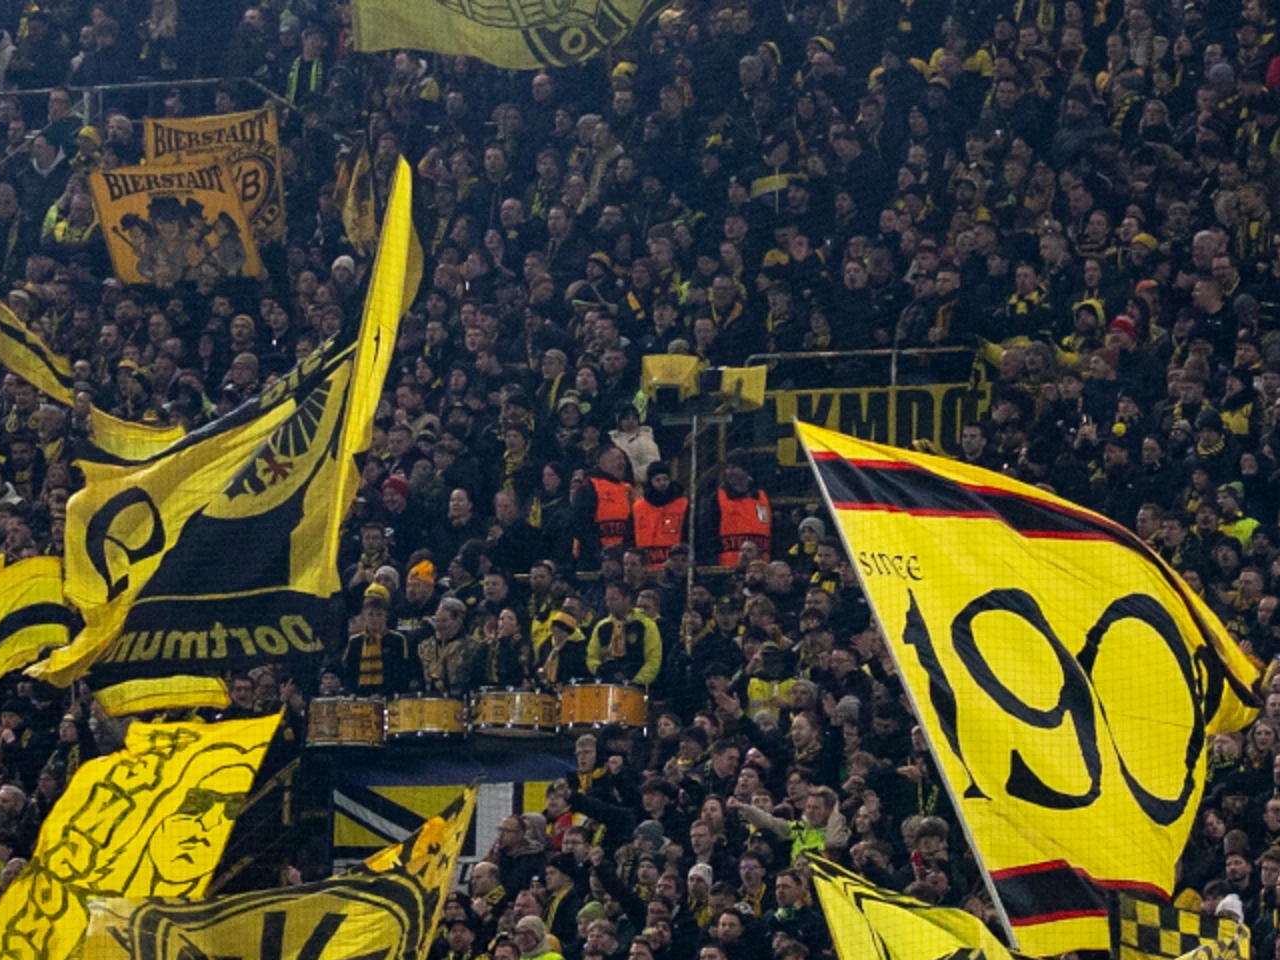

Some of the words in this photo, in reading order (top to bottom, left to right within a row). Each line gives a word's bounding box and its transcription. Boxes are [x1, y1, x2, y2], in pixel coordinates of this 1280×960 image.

[152, 111, 269, 158] BIERSTADT
[103, 165, 226, 201] BIERSTADT
[859, 551, 924, 581] SINCE
